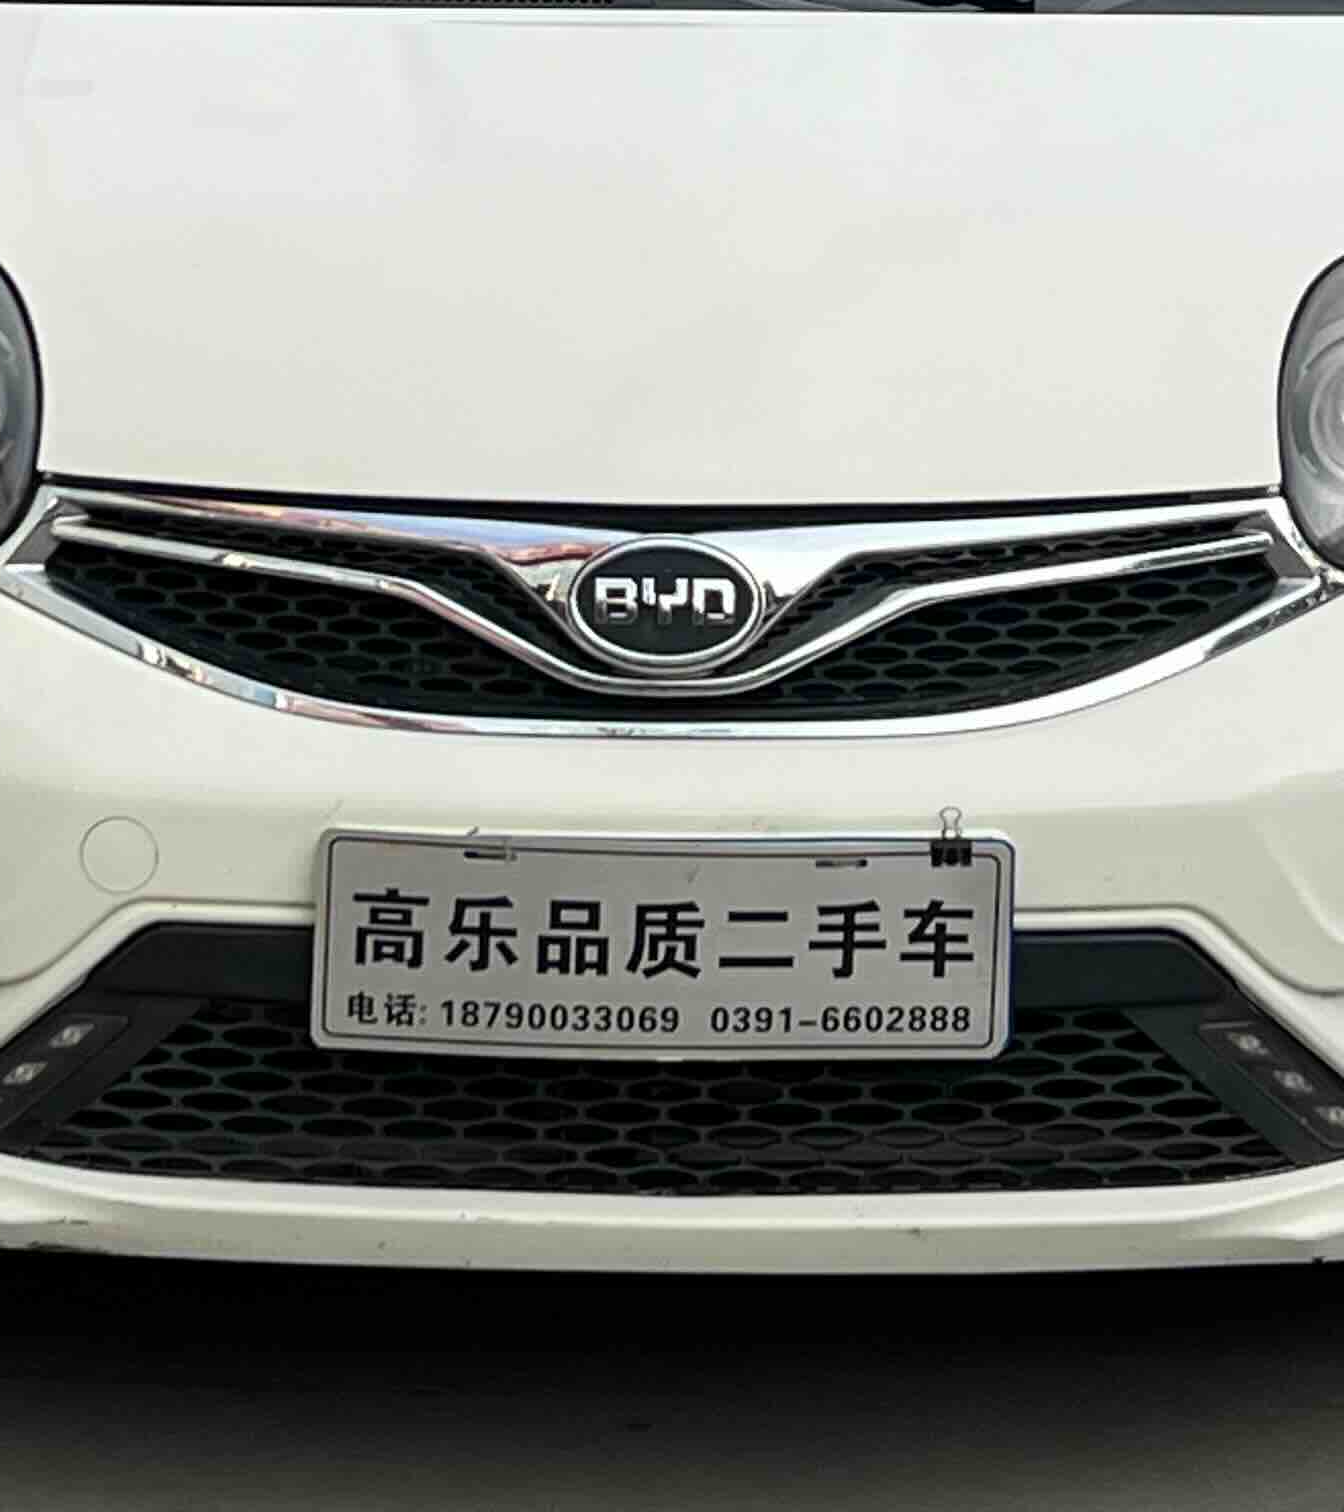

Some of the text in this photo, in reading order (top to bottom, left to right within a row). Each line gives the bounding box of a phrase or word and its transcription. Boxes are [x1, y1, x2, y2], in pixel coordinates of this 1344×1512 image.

[594, 577, 736, 625] BYD
[352, 888, 976, 979] 高乐品质二手车
[441, 999, 680, 1034] 18790033069
[710, 1005, 971, 1034] 0391-6602888
